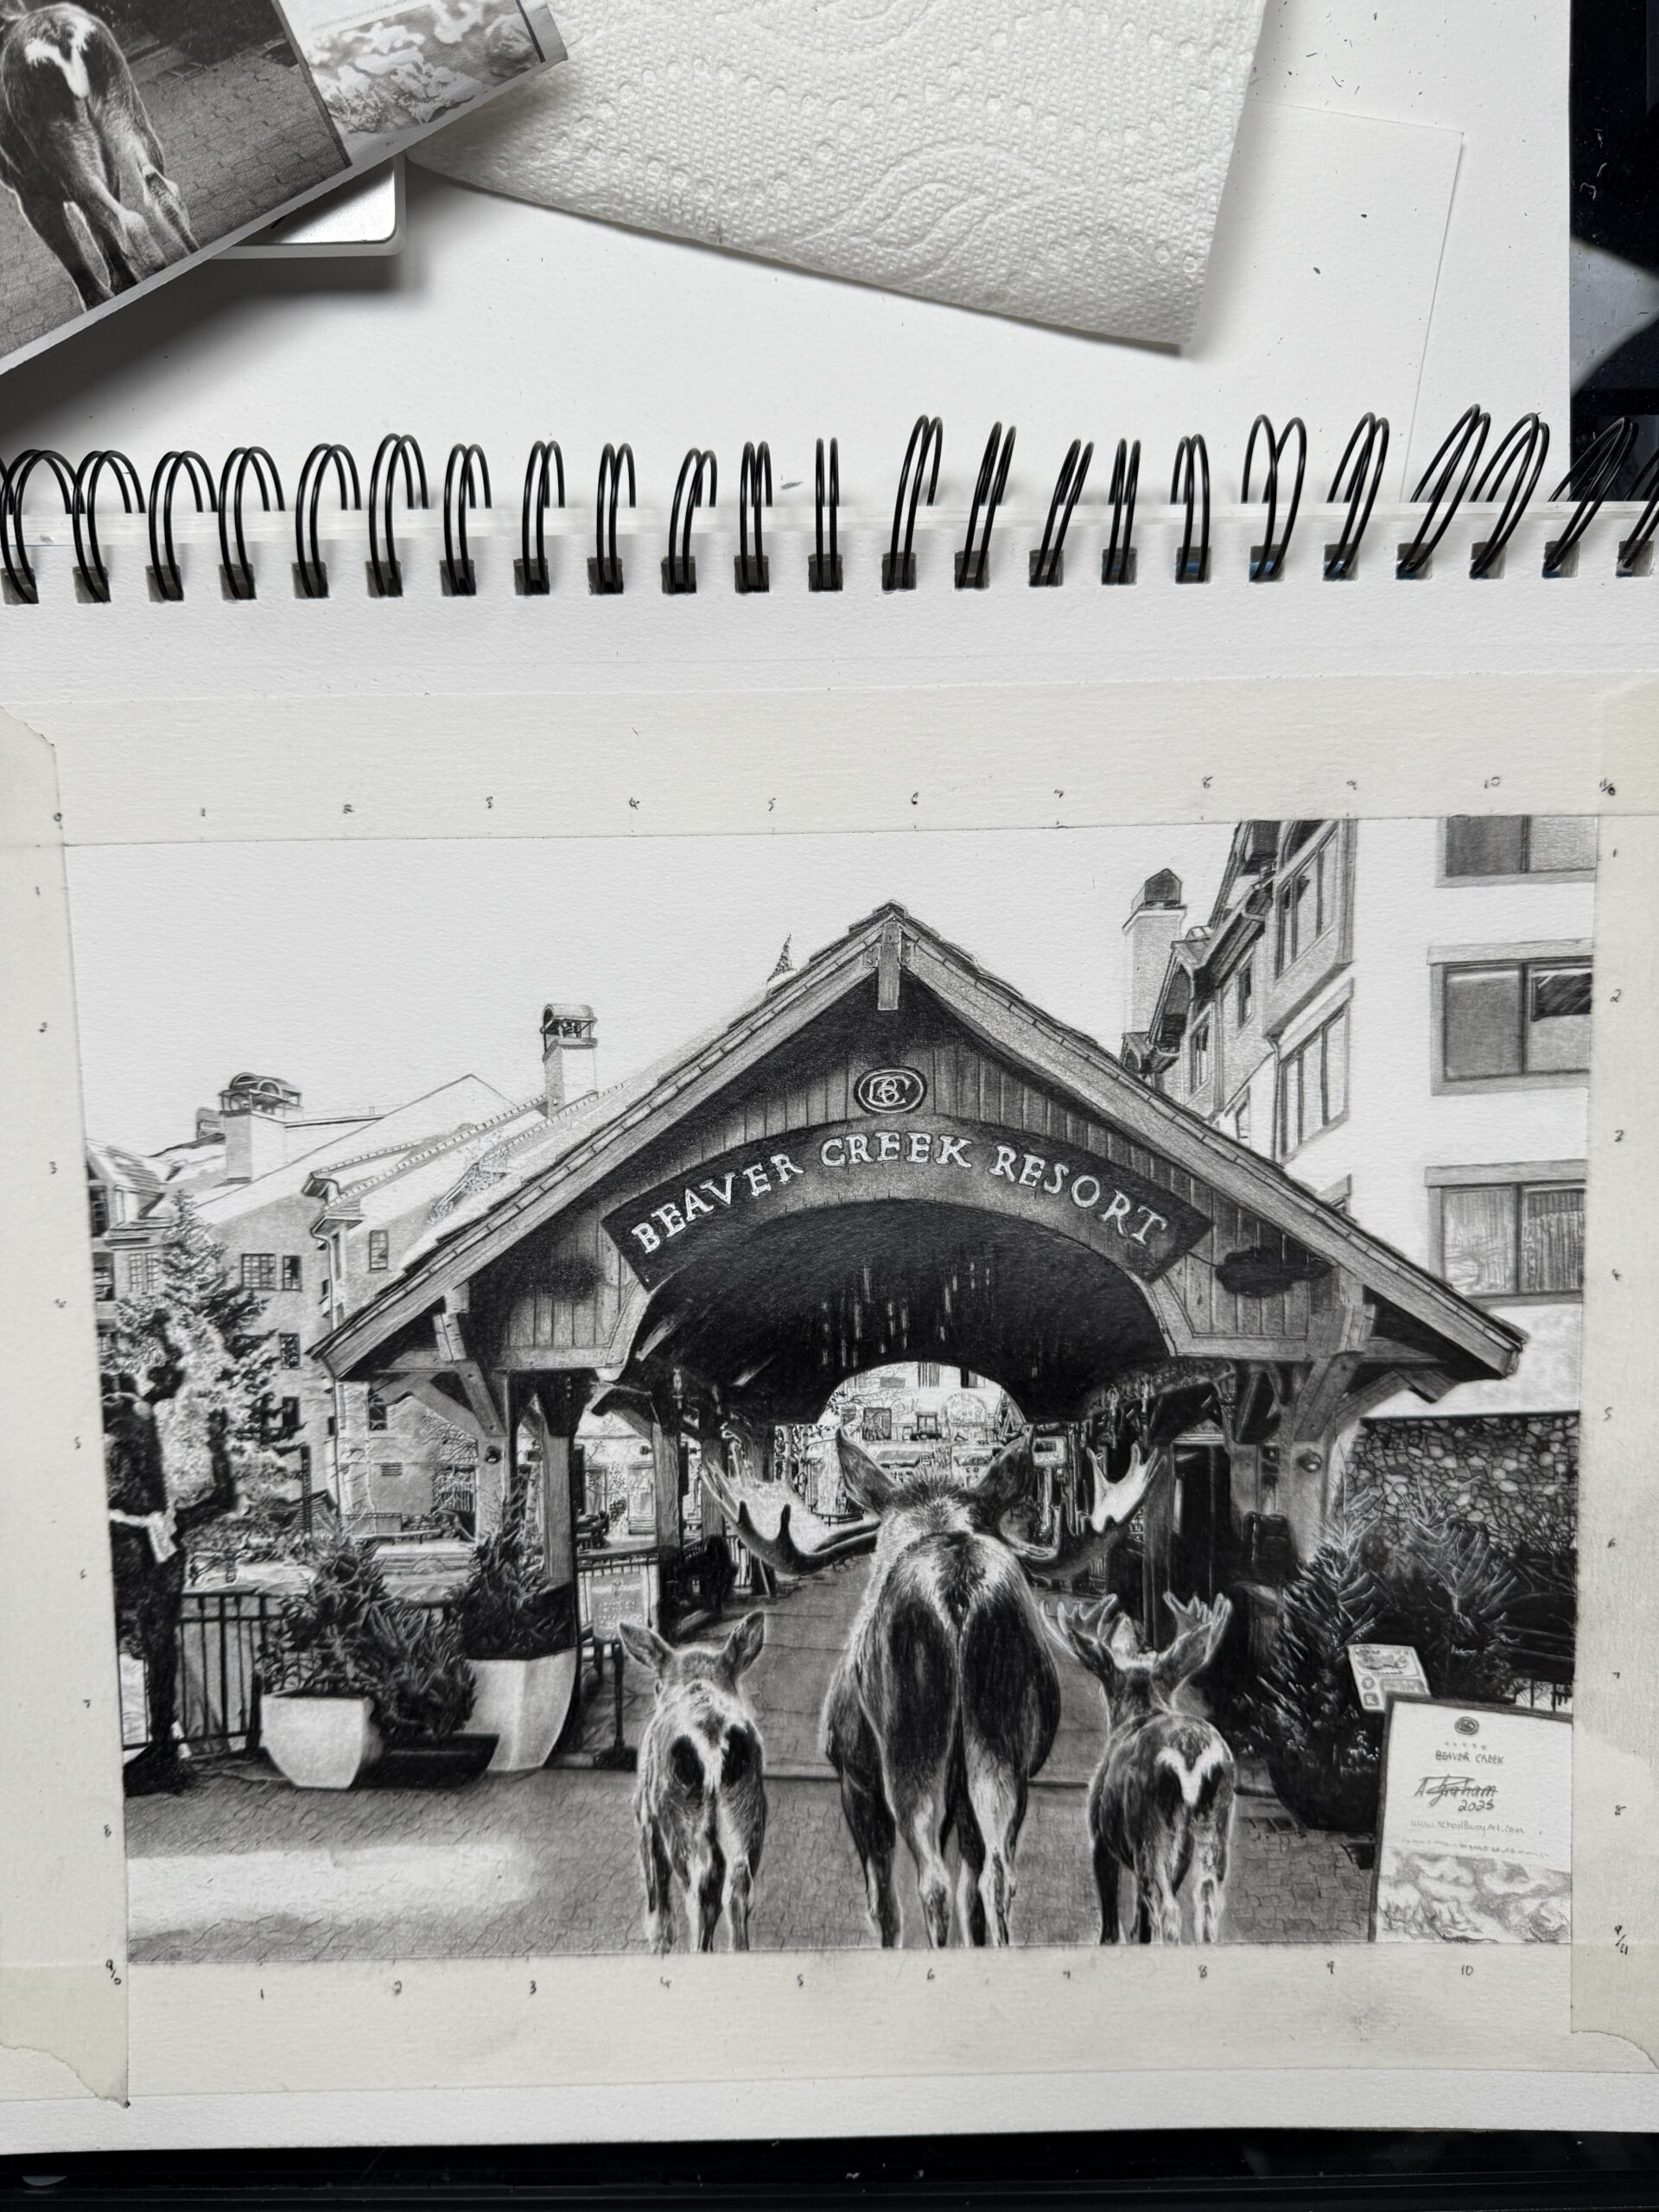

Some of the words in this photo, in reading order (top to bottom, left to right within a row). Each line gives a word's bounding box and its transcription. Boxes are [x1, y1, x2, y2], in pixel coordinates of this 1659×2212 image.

[631, 1154, 804, 1254] BEAVER
[821, 1132, 972, 1167] CREEK
[988, 1146, 1168, 1245] RESORT
[1435, 1750, 1470, 1763] BEAVER
[1475, 1752, 1504, 1764] CREEK
[1458, 1798, 1495, 1812] 2025
[1460, 1964, 1474, 1977] 10
